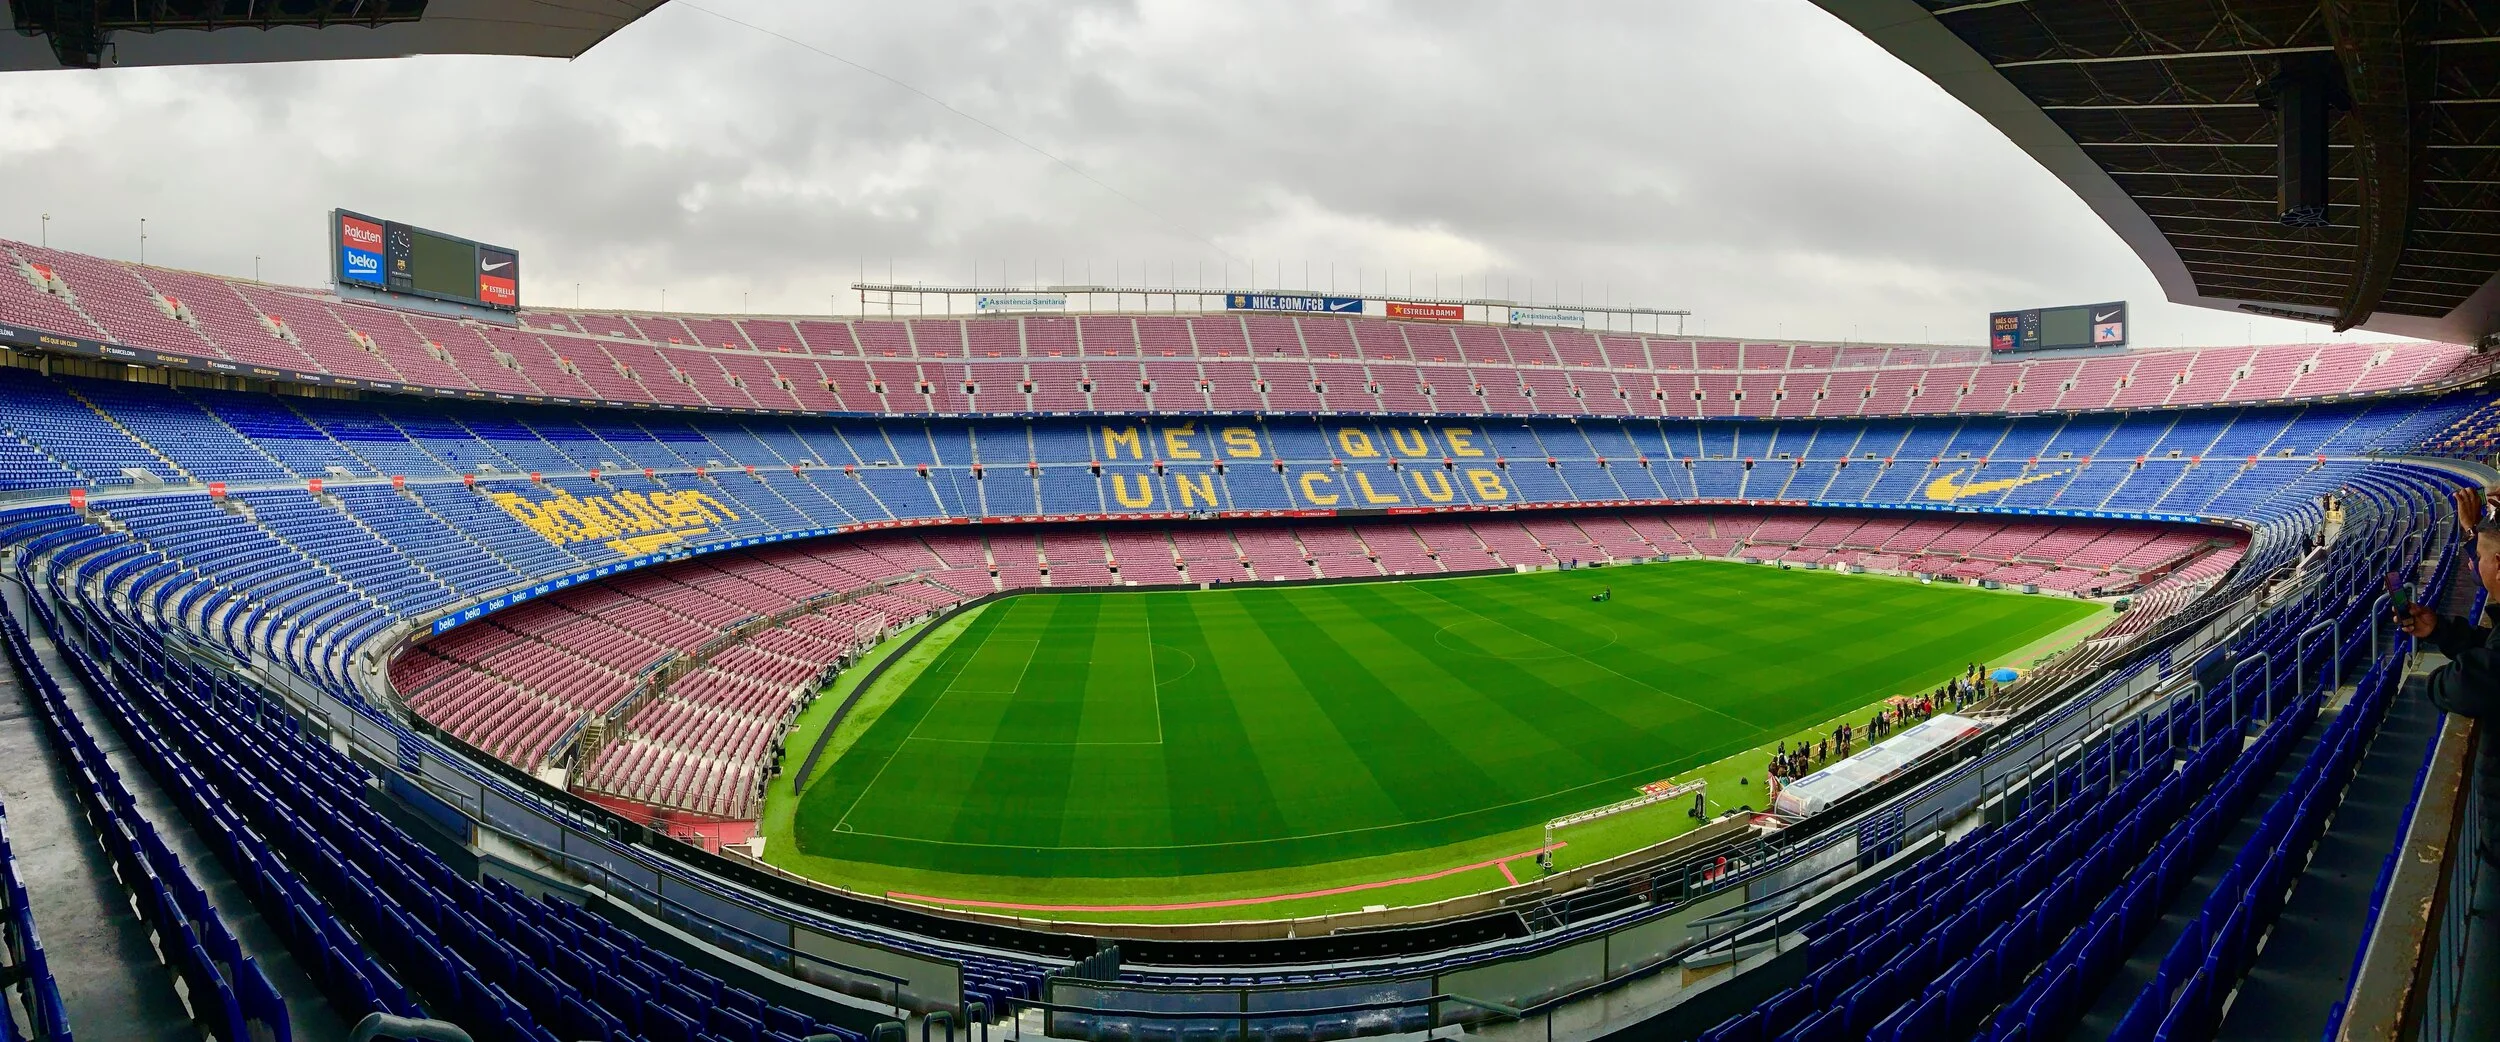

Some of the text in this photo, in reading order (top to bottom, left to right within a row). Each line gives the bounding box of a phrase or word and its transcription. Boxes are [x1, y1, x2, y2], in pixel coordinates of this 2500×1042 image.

[345, 224, 382, 244] Rakuten
[349, 251, 377, 269] beko
[489, 285, 515, 296] ESTRELLA
[1252, 296, 1324, 311] NIKE.COM/FCB
[1403, 308, 1457, 317] ESTRELLA DAMM
[112, 348, 136, 357] BARCELONA
[1102, 420, 1484, 459] MÉS QUE
[1113, 469, 1509, 508] UN CLUB
[491, 489, 740, 545] Rakuten
[695, 546, 707, 554] beko
[634, 558, 646, 567] beko
[653, 554, 664, 563] beko
[596, 567, 608, 576] beko
[615, 562, 627, 571] beko
[576, 573, 589, 582] beko
[556, 578, 569, 589] beko
[535, 584, 549, 595] beko
[512, 591, 527, 603] beko
[489, 599, 505, 610] beko
[465, 607, 480, 620] beko
[438, 617, 455, 631] beko
